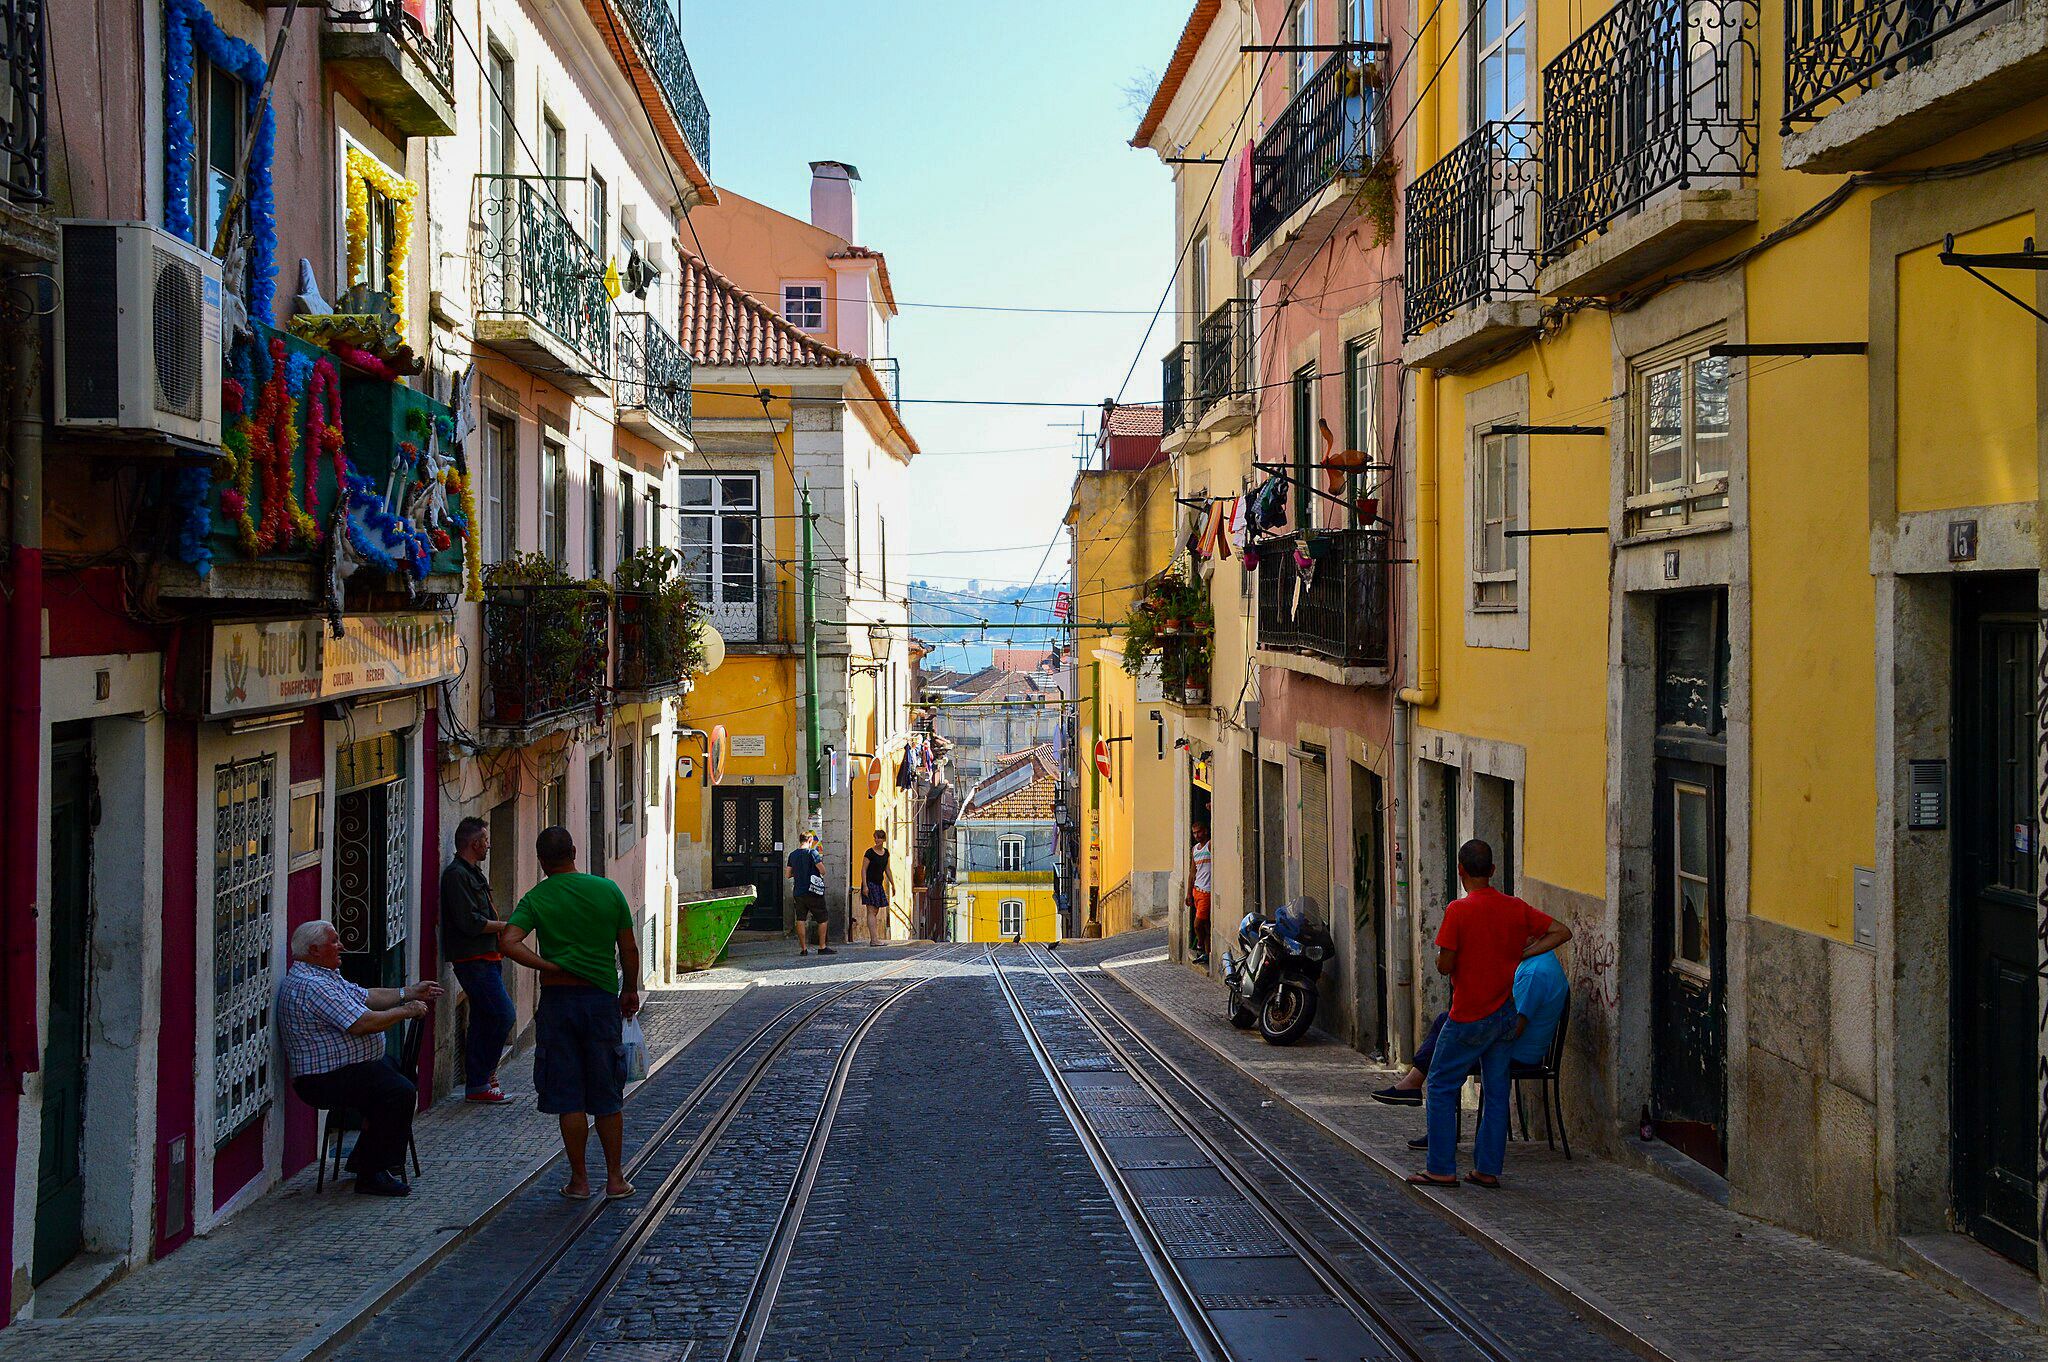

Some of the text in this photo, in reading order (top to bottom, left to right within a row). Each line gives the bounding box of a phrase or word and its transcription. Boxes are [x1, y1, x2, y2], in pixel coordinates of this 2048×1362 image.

[1953, 525, 1968, 557] 15
[1666, 553, 1675, 576] 13
[258, 630, 307, 678] GRUPO
[333, 671, 354, 687] CULTURA
[366, 668, 385, 682] RECREIO
